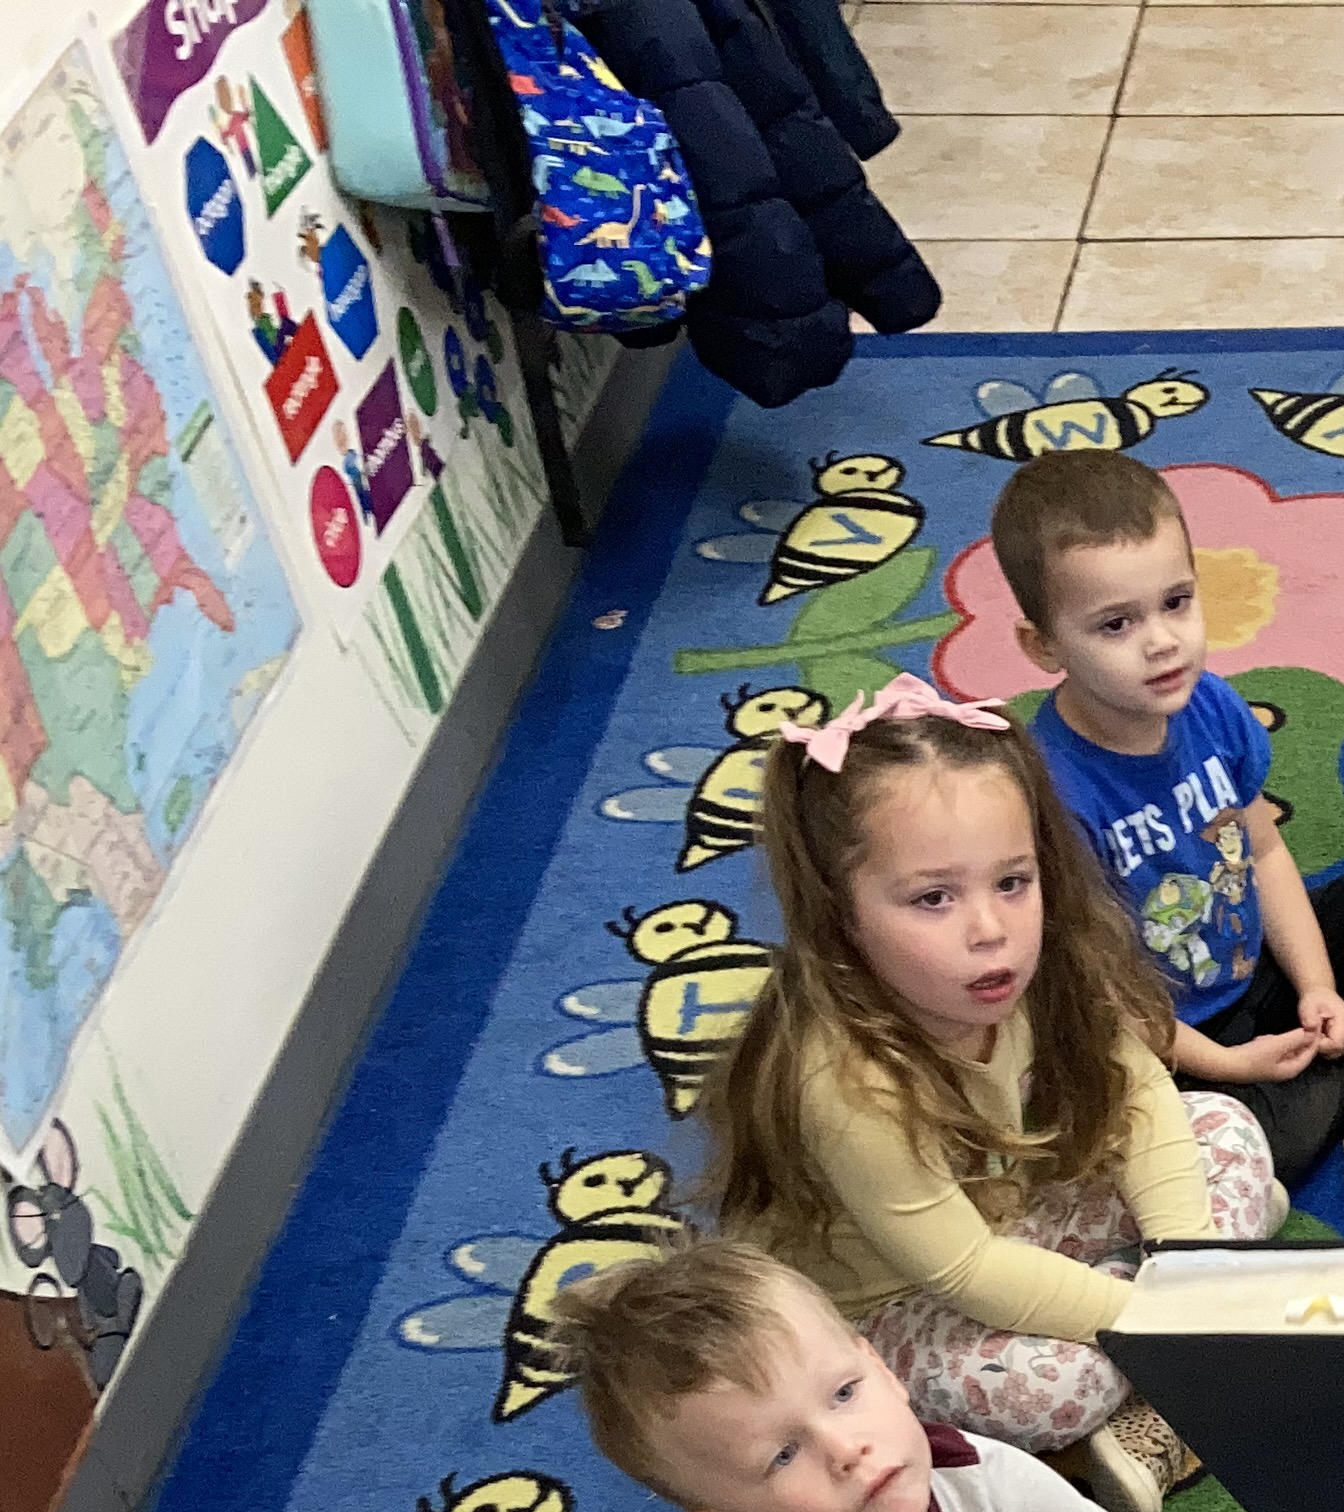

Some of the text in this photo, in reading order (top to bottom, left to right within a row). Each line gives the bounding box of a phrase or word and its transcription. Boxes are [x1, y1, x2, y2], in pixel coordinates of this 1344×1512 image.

[1032, 412, 1107, 449] W
[810, 512, 888, 553] V
[1104, 803, 1177, 877] LETS
[676, 981, 755, 1035] T
